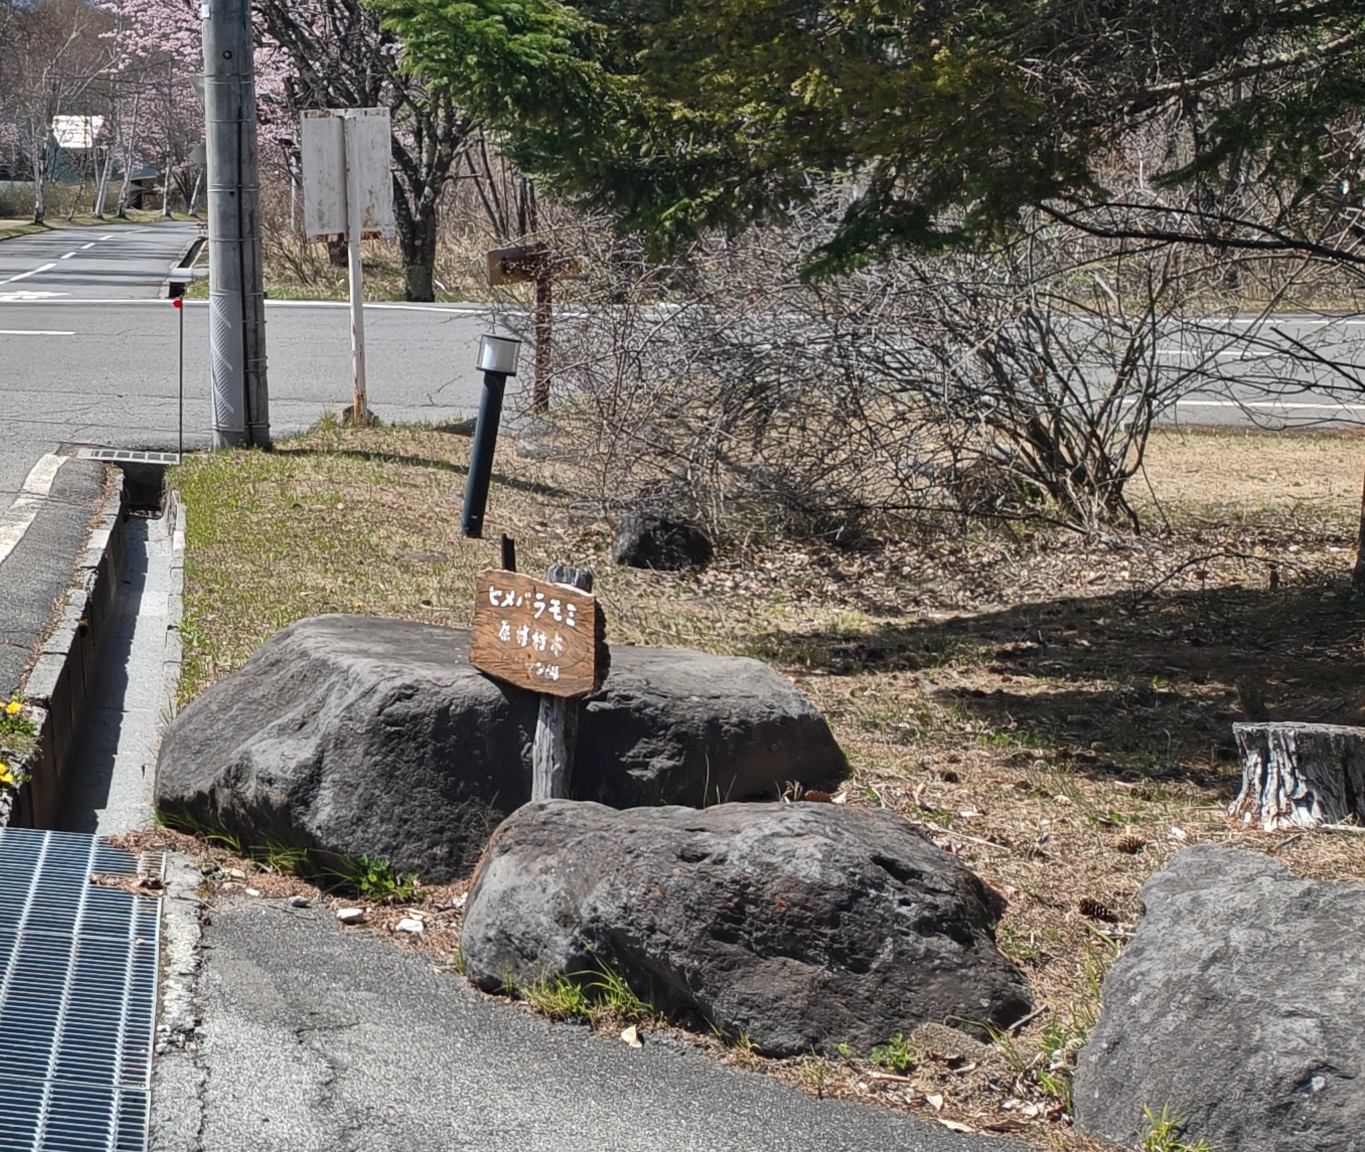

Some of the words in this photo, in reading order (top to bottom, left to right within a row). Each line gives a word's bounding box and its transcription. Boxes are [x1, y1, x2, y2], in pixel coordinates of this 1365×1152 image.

[488, 585, 578, 627] ヒメバラモミ
